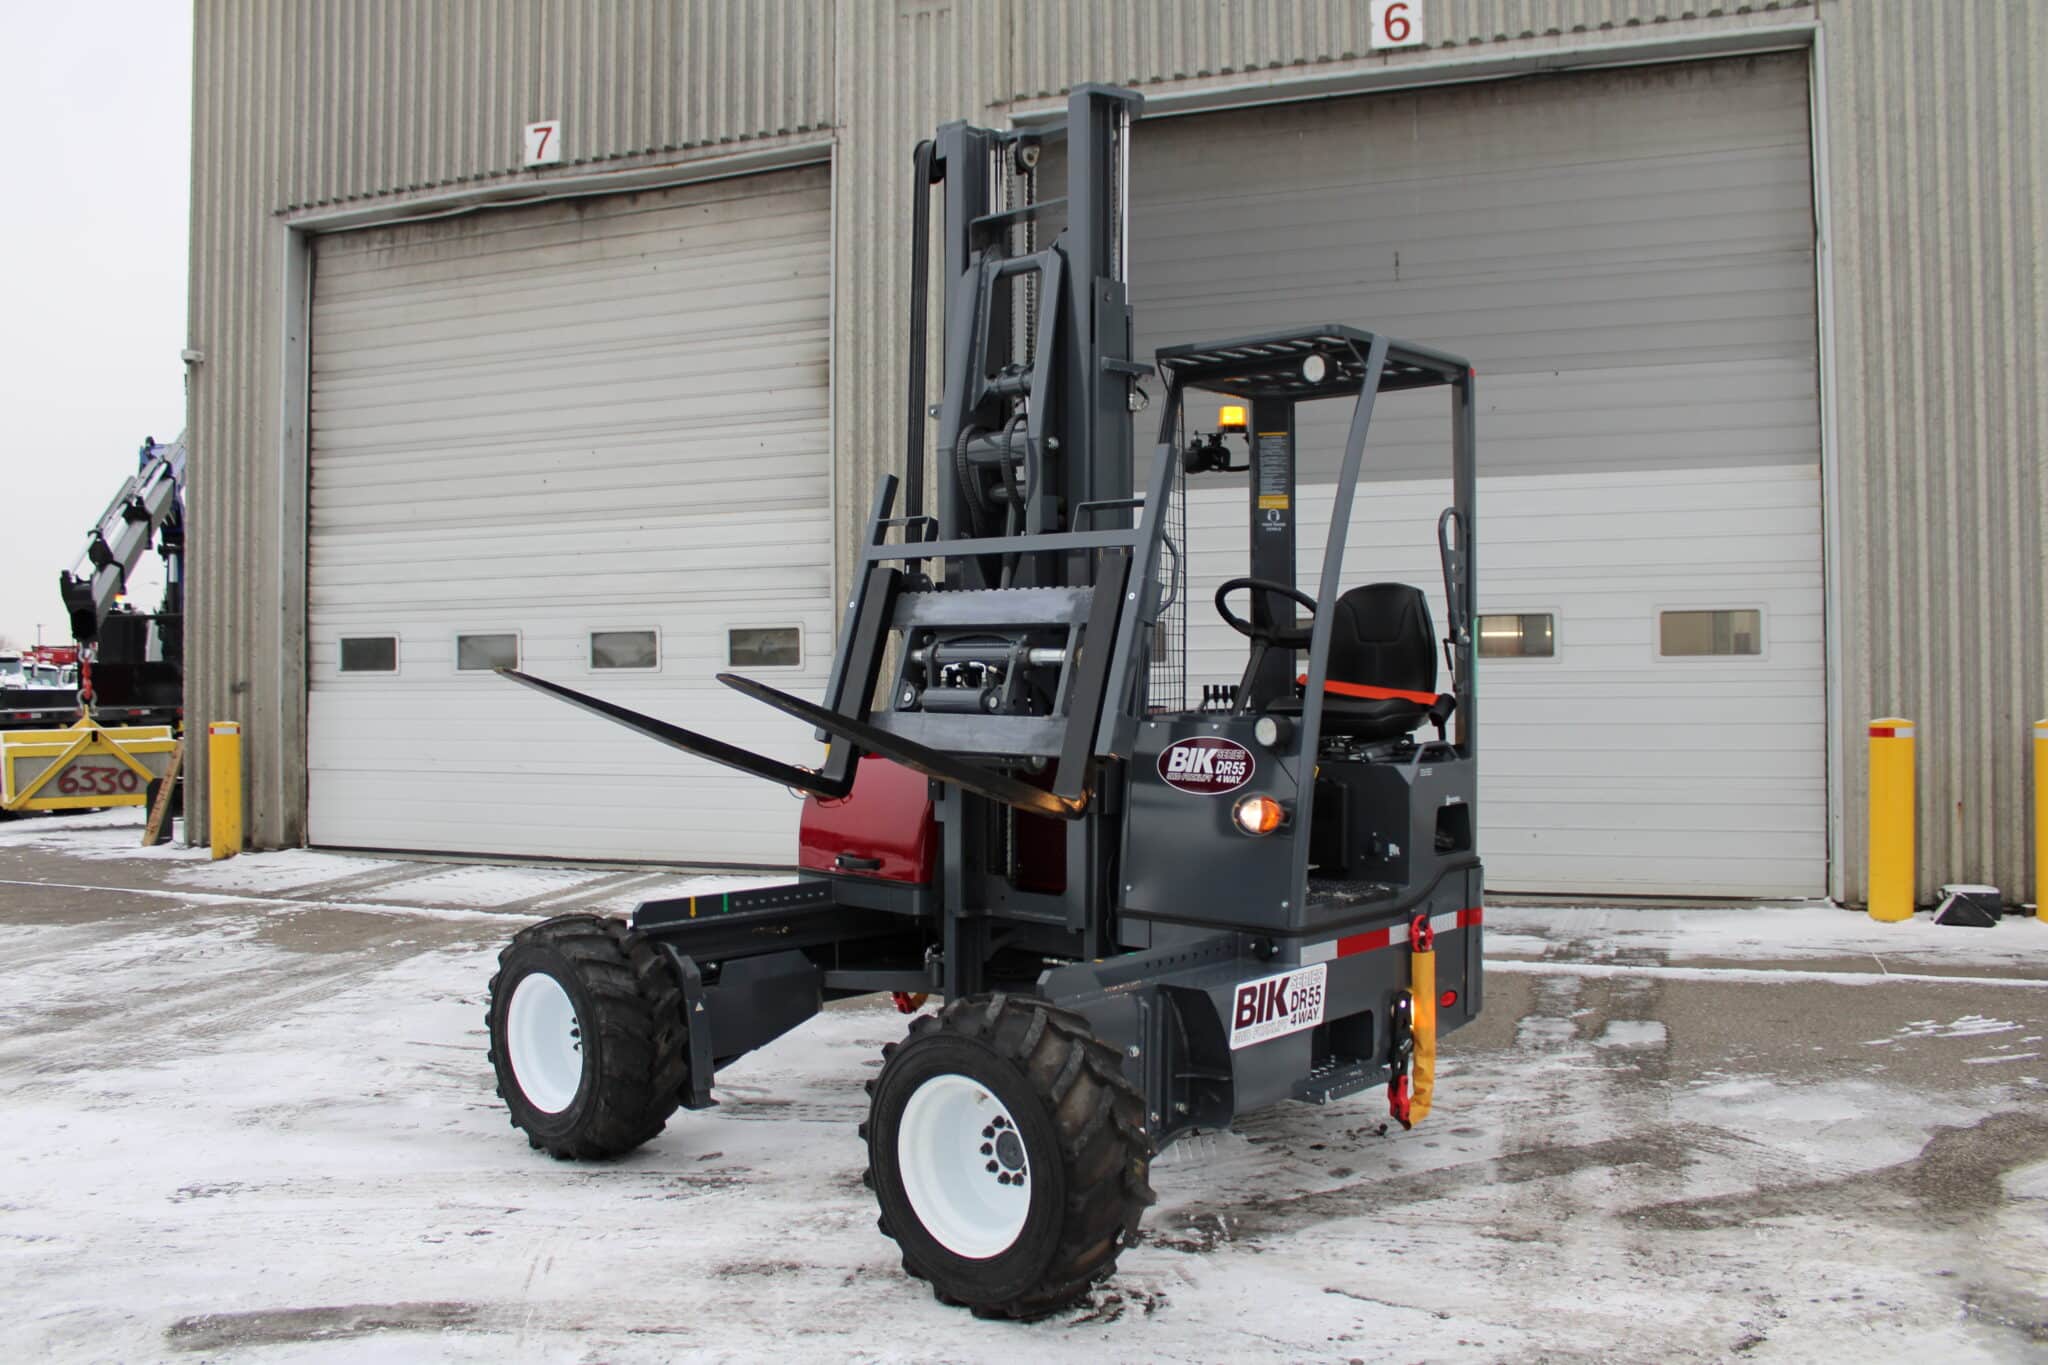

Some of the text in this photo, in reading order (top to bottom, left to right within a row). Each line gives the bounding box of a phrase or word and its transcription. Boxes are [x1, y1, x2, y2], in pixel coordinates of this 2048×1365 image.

[1384, 2, 1410, 42] 6
[533, 126, 552, 160] 7
[1167, 746, 1217, 774] BIK
[1215, 760, 1247, 776] DR55
[57, 764, 138, 795] 6330
[1234, 976, 1291, 1031] BIK
[1290, 985, 1322, 1013] DR55
